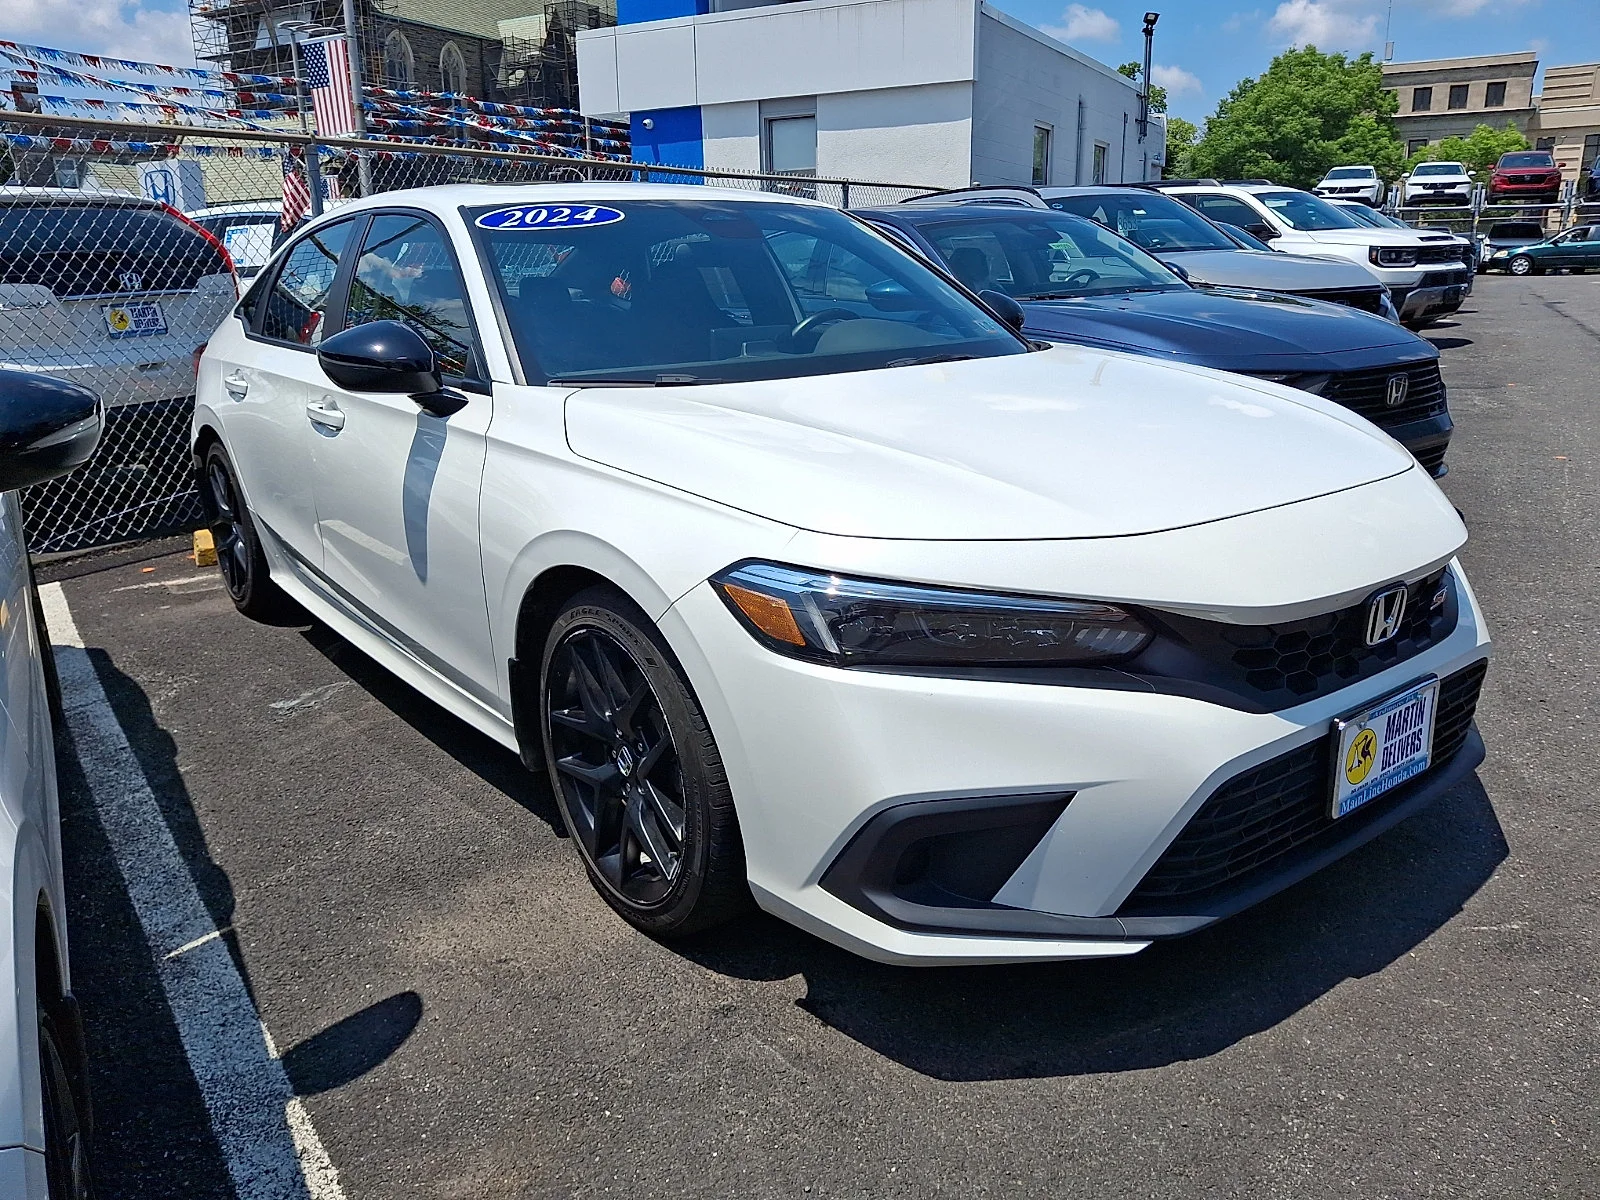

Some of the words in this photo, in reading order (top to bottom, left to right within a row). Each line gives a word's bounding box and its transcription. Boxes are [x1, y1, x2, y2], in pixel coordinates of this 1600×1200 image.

[498, 206, 599, 228] 2024
[570, 607, 601, 620] EAGLE
[1384, 697, 1427, 744] MARTIN
[1381, 728, 1423, 772] DELIVERS
[1341, 761, 1426, 815] MainLineHonda.com
